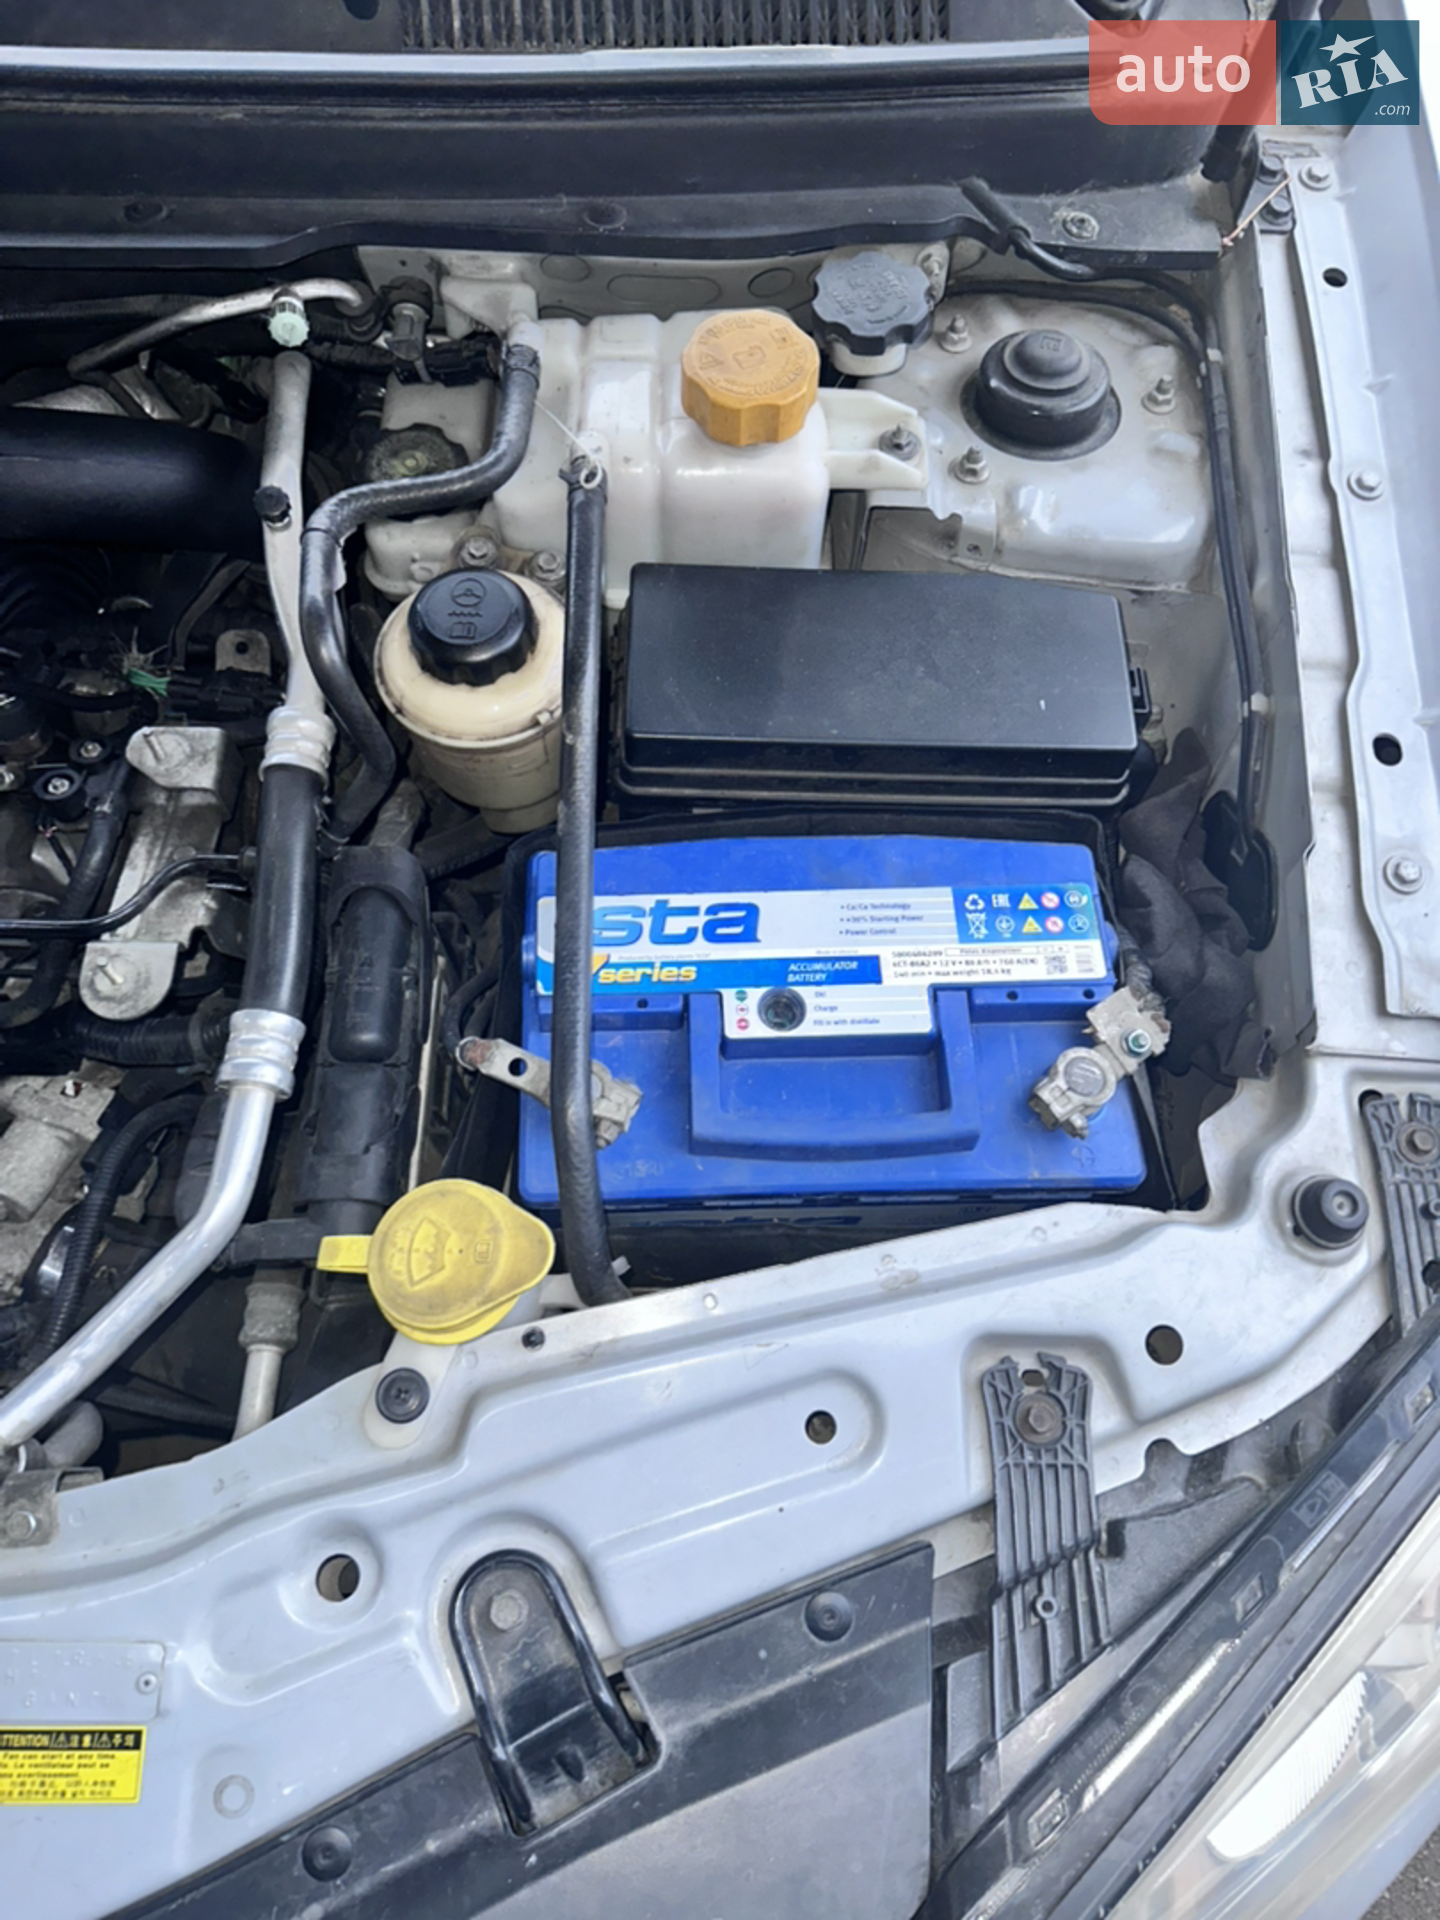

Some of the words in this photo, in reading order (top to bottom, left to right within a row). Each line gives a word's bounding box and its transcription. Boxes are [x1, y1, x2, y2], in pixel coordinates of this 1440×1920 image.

[869, 901, 912, 911] Technology
[900, 912, 924, 922] Power
[593, 899, 762, 947] sta
[844, 926, 868, 936] Power
[868, 925, 897, 935] Control
[788, 960, 860, 973] ACCUMULATOR
[598, 962, 698, 984] series
[787, 973, 827, 983] BATTERY
[813, 1004, 838, 1014] Charge
